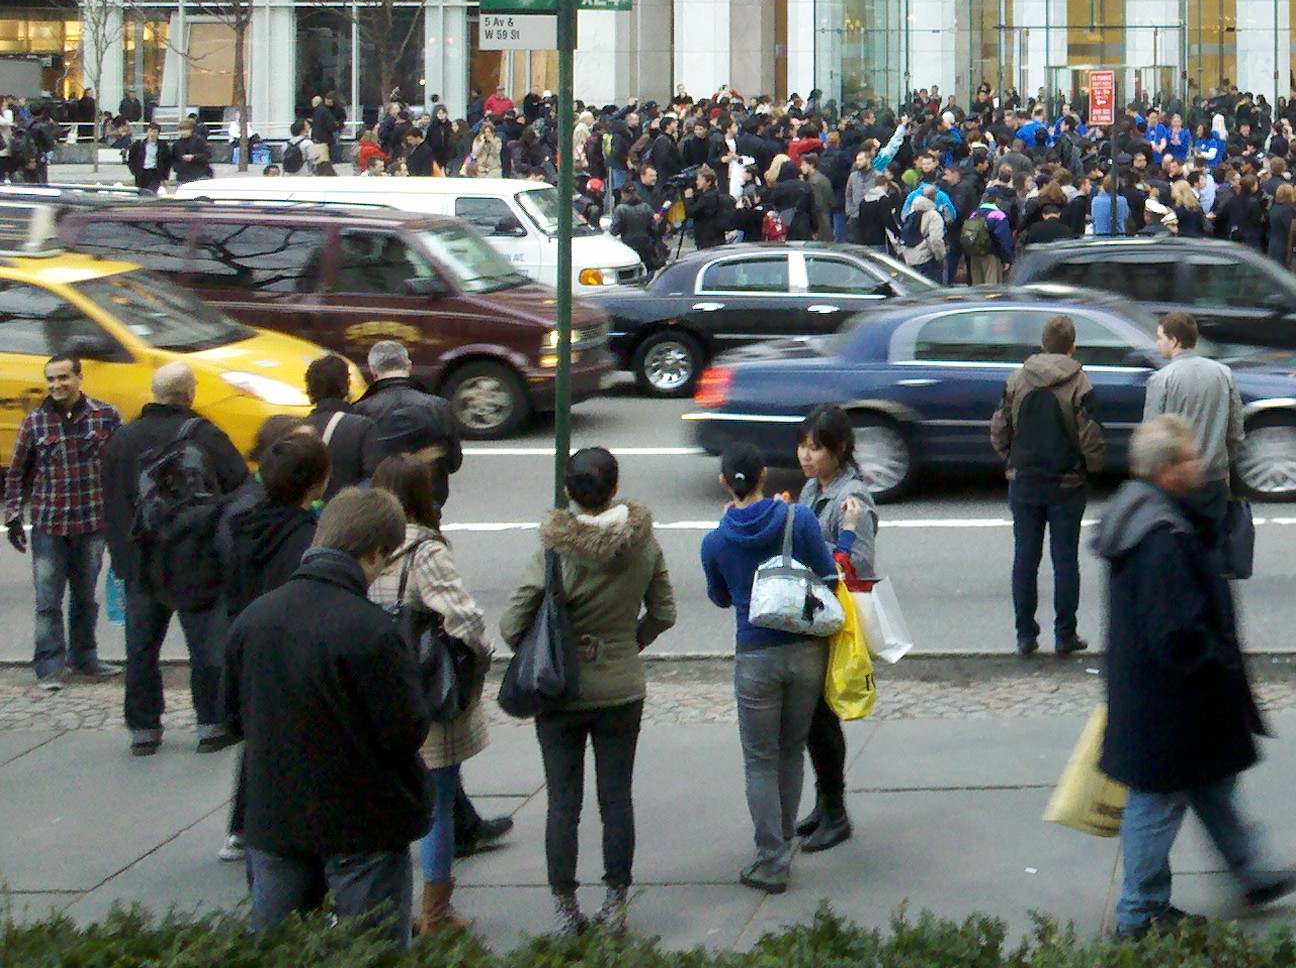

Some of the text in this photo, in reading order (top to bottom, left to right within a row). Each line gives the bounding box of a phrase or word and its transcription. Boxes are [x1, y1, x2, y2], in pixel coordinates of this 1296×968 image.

[484, 17, 514, 27] 5 Av &
[484, 30, 520, 40] W 59 St
